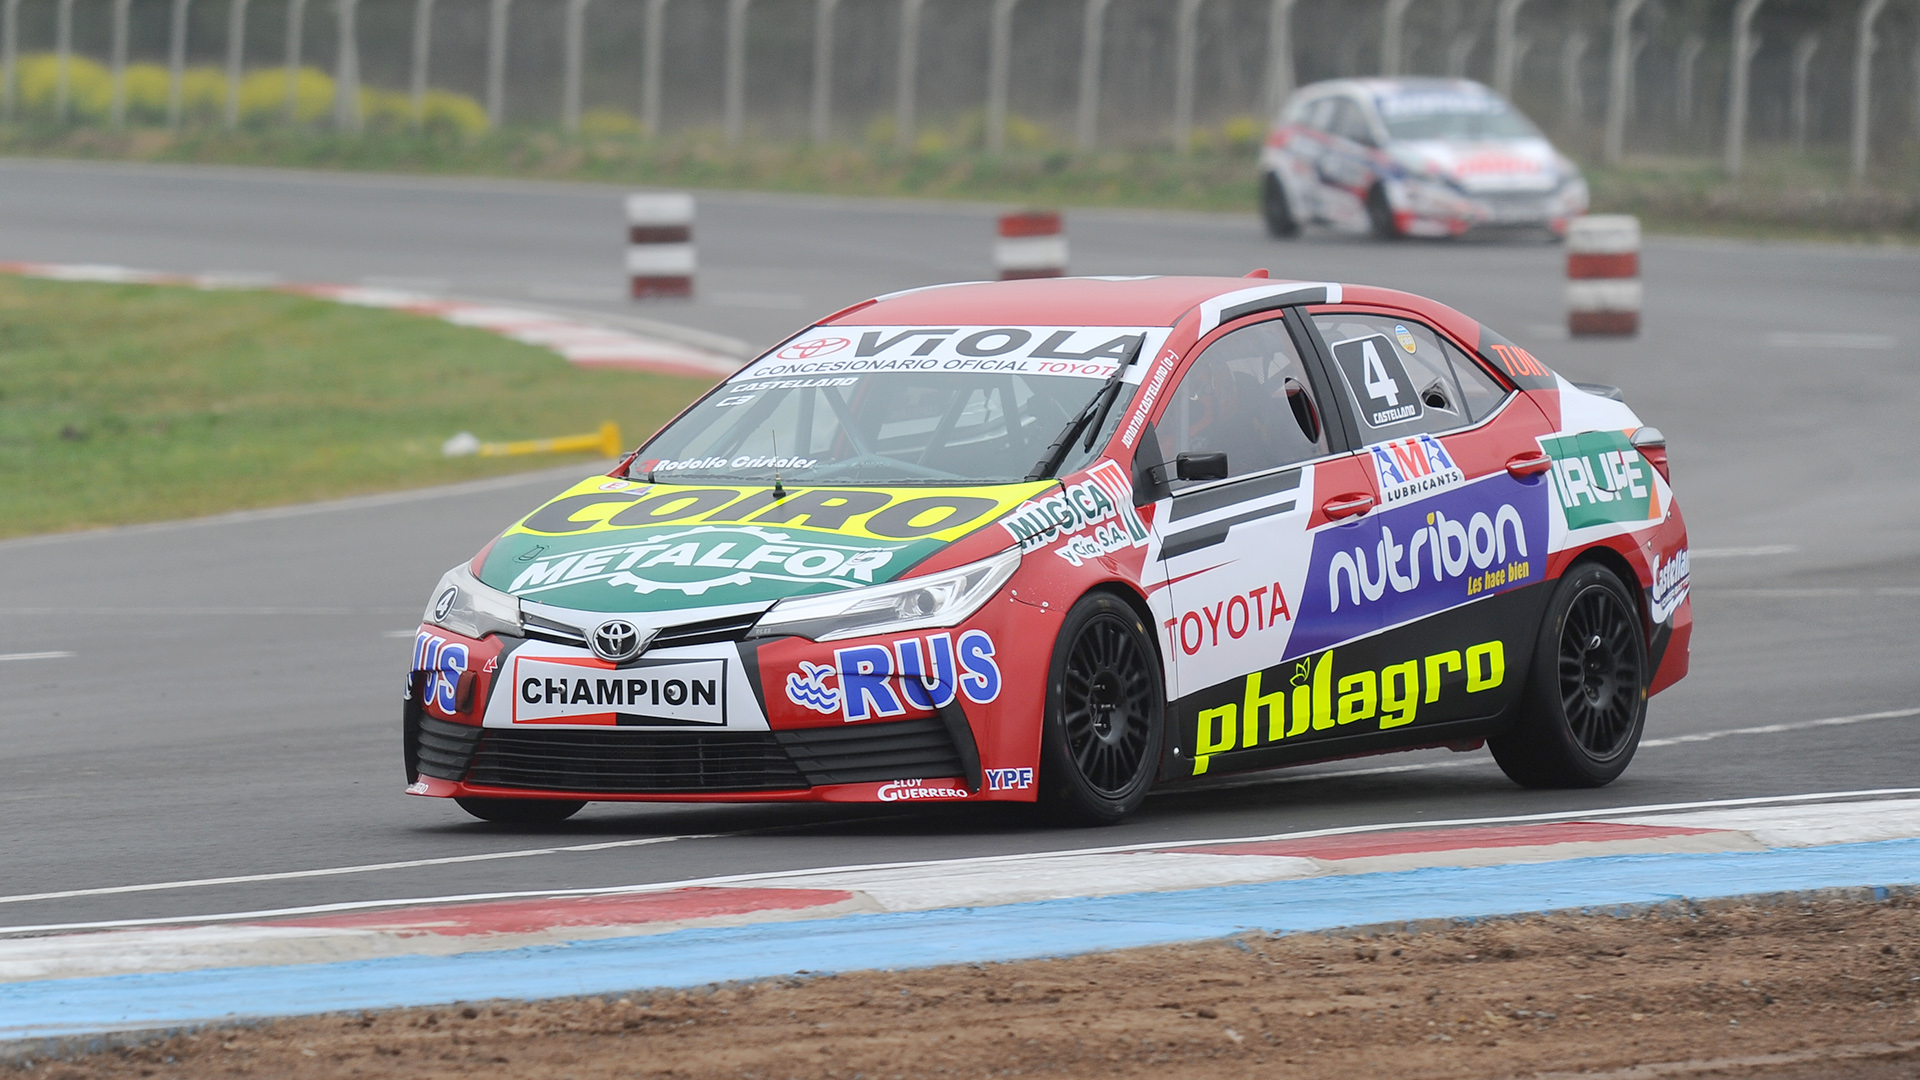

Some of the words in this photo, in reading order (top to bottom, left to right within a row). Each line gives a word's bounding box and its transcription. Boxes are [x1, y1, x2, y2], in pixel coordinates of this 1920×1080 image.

[855, 328, 1143, 366] VIOLA
[730, 376, 859, 393] CASTELLANO
[754, 359, 939, 377] CONCESIONARIO
[943, 358, 1028, 371] OFICIAL
[1362, 340, 1399, 407] 4
[1121, 409, 1147, 449] JONATAN
[1373, 404, 1416, 424] CASTELLANO
[652, 456, 728, 472] Rodolfo
[730, 455, 818, 469] Cristales
[1372, 435, 1453, 488] AMA
[1387, 471, 1459, 502] LUBRICANTS
[521, 488, 1000, 538] COIRO
[1006, 484, 1112, 549] MUGICA
[1098, 527, 1127, 546] S.A.
[507, 541, 894, 592] METALFOR
[1328, 503, 1528, 613] nutribon
[1466, 575, 1484, 596] Les
[1484, 569, 1506, 591] hace
[1507, 561, 1530, 583] bien
[436, 590, 456, 616] 4
[1164, 581, 1291, 663] TOYOTA
[520, 678, 717, 706] CHAMPION
[834, 629, 1001, 722] RUS
[1191, 640, 1506, 776] philagro
[877, 784, 968, 802] GUERRERO
[894, 778, 923, 787] ELOY
[985, 767, 1034, 791] YPF
